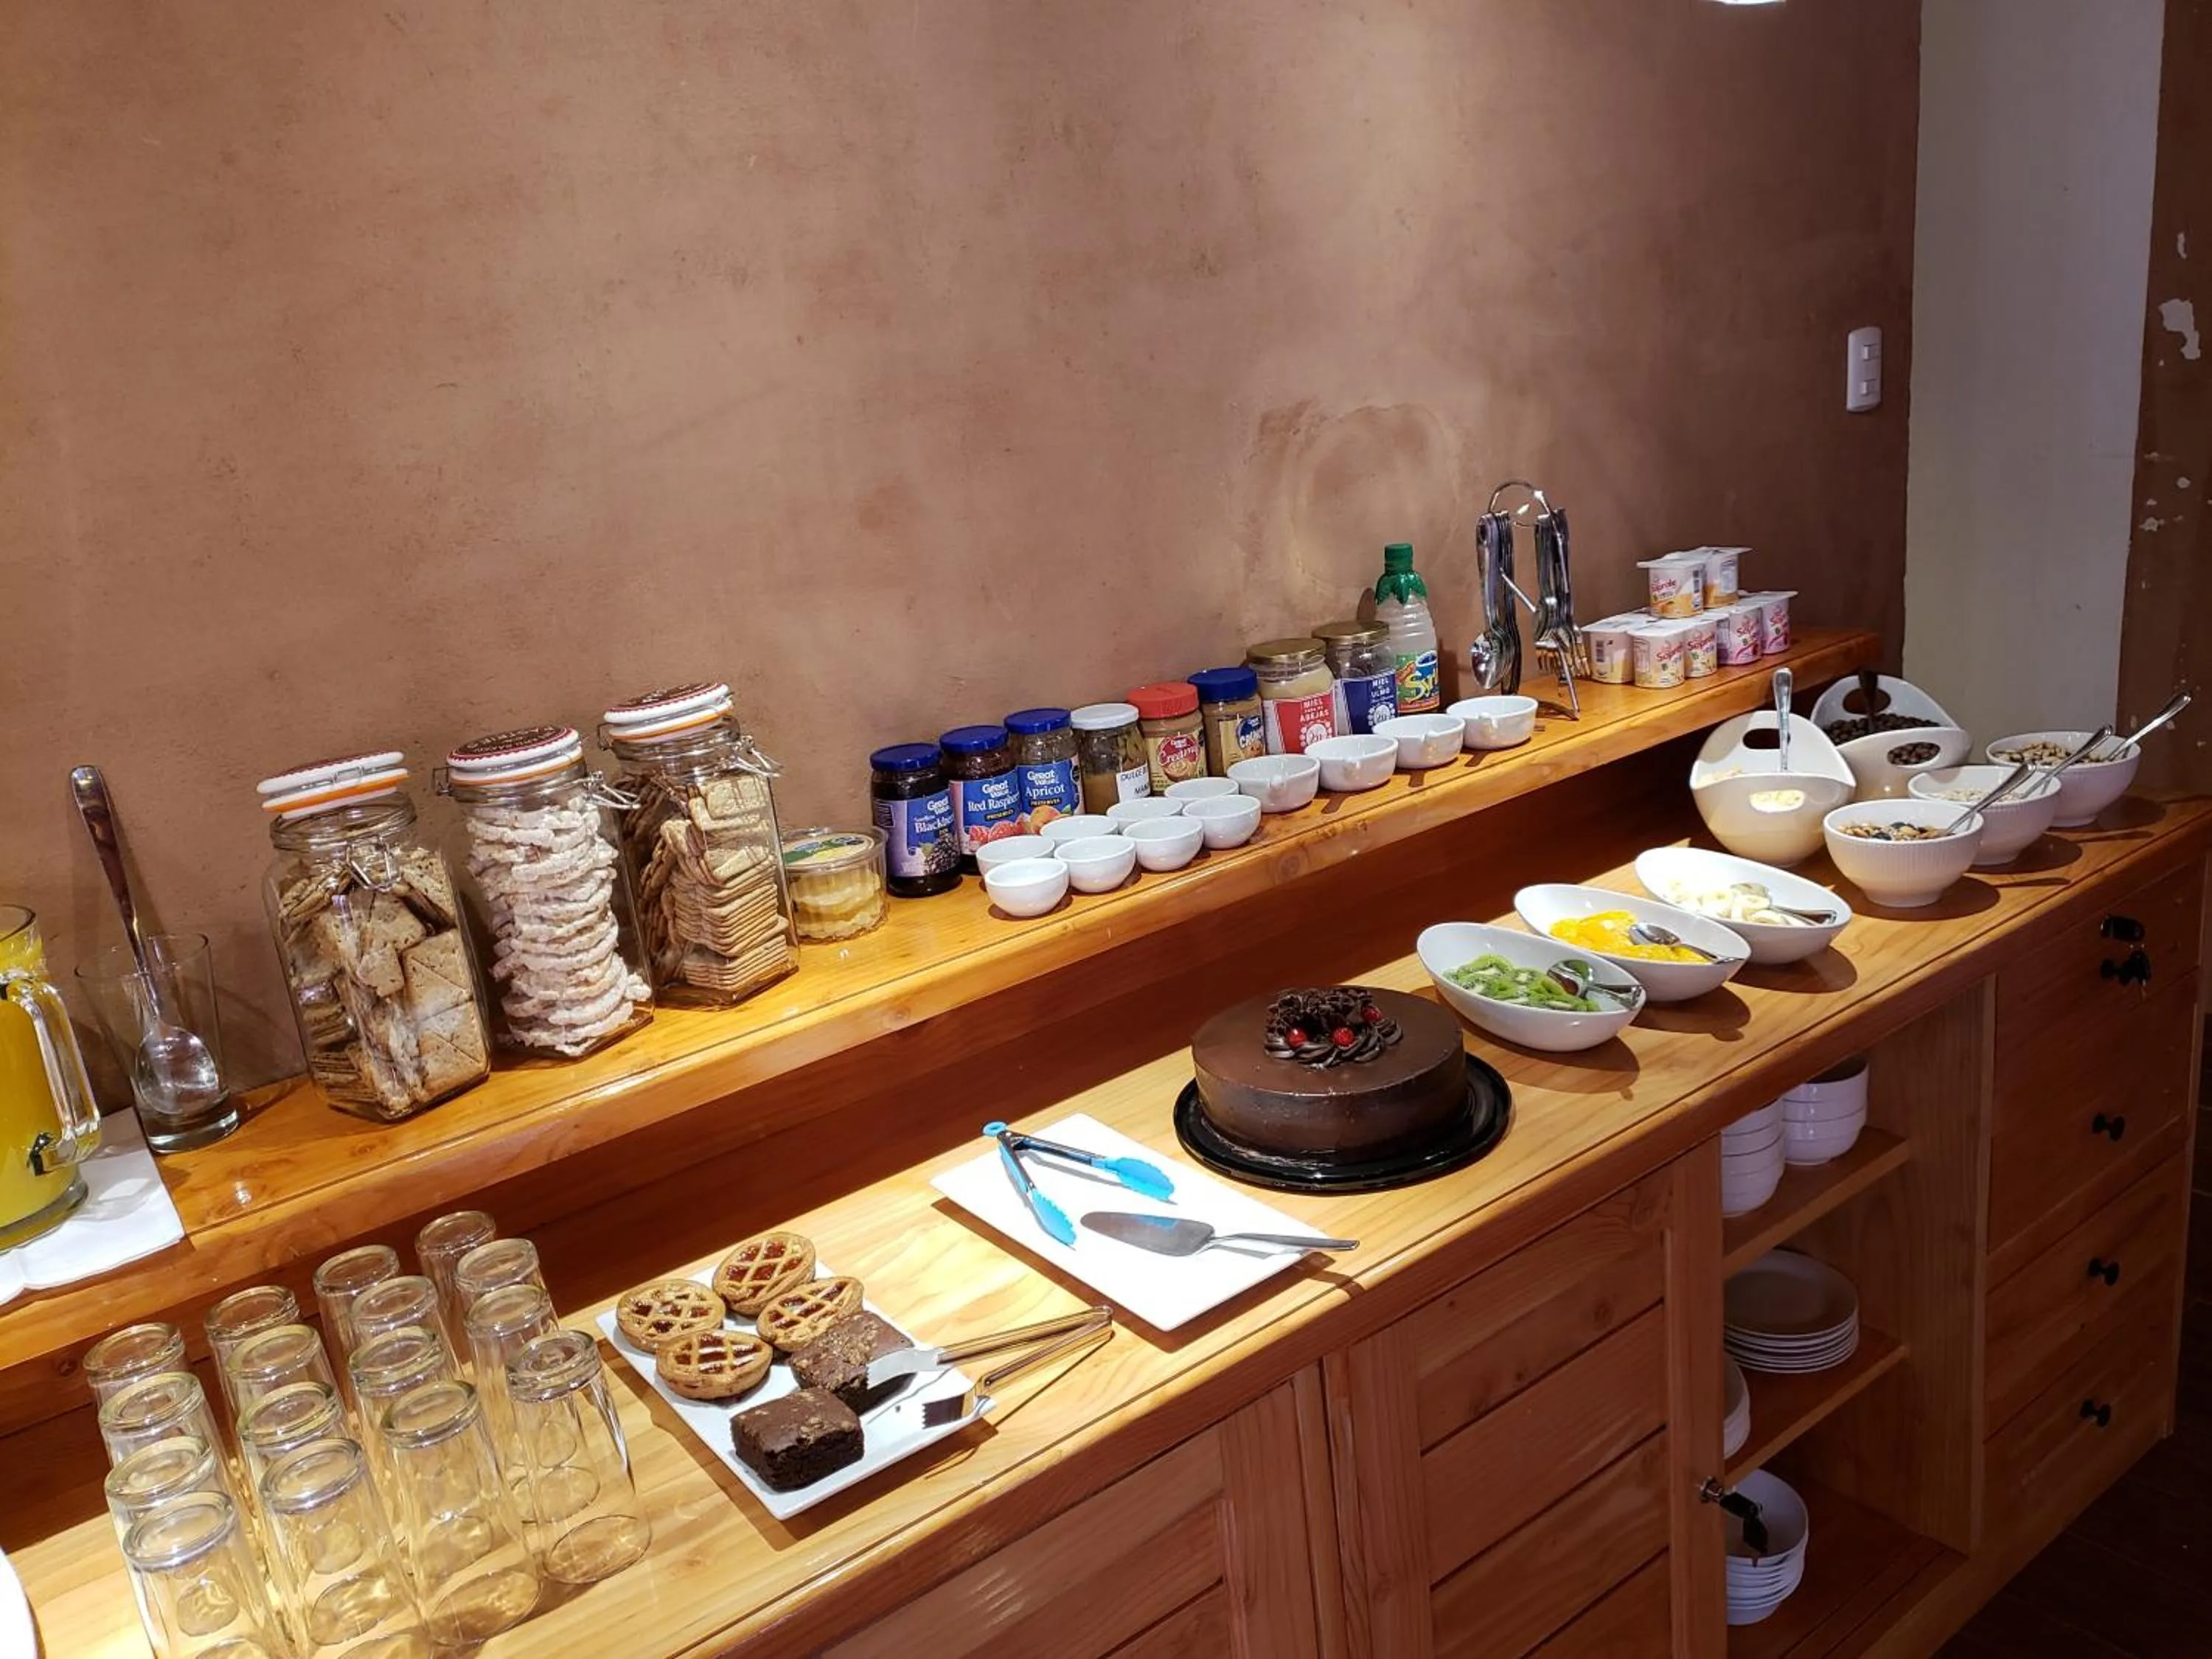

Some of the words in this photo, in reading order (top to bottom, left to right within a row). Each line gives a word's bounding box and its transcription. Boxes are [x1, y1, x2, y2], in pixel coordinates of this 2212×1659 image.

[1372, 677, 1388, 686] MIEL
[1371, 687, 1390, 698] ULMO
[1303, 698, 1324, 709] MIEL
[1300, 709, 1329, 722] ABEJAS
[1158, 746, 1198, 766] Creamy
[1027, 769, 1056, 781] Great
[981, 780, 1009, 794] Great
[1034, 777, 1057, 786] Value
[990, 789, 1010, 799] Value
[1025, 784, 1065, 800] Apricot
[927, 796, 950, 811] Great
[967, 799, 987, 812] Red
